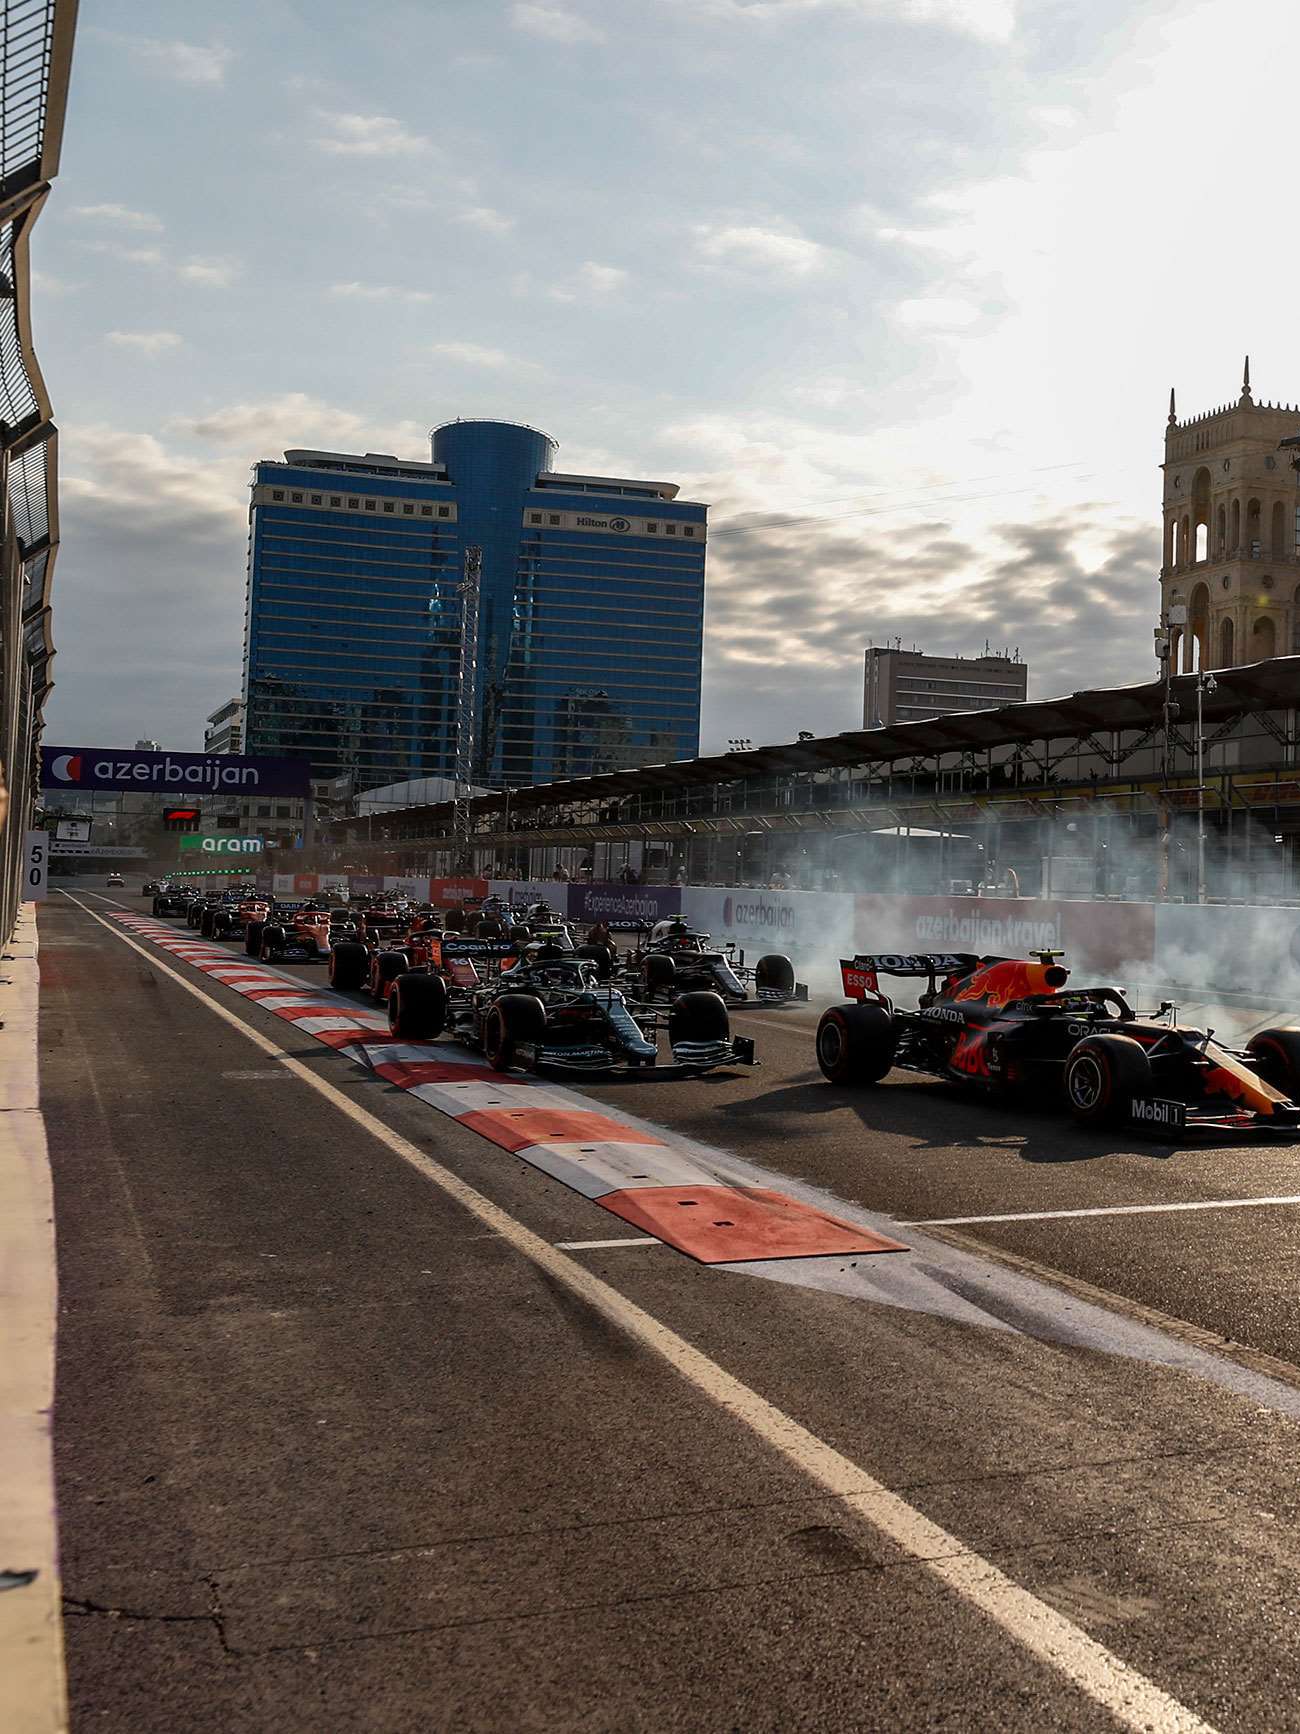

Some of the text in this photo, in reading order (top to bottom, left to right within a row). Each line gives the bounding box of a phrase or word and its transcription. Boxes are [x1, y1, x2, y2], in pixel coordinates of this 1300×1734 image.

[576, 516, 608, 528] Hilton
[94, 757, 260, 790] azerbaijan
[202, 838, 264, 851] aram
[30, 846, 43, 886] 50
[735, 896, 796, 930] azerbaijan
[916, 906, 1060, 949] azerbaijan.travel
[1131, 1099, 1169, 1123] Mobil
